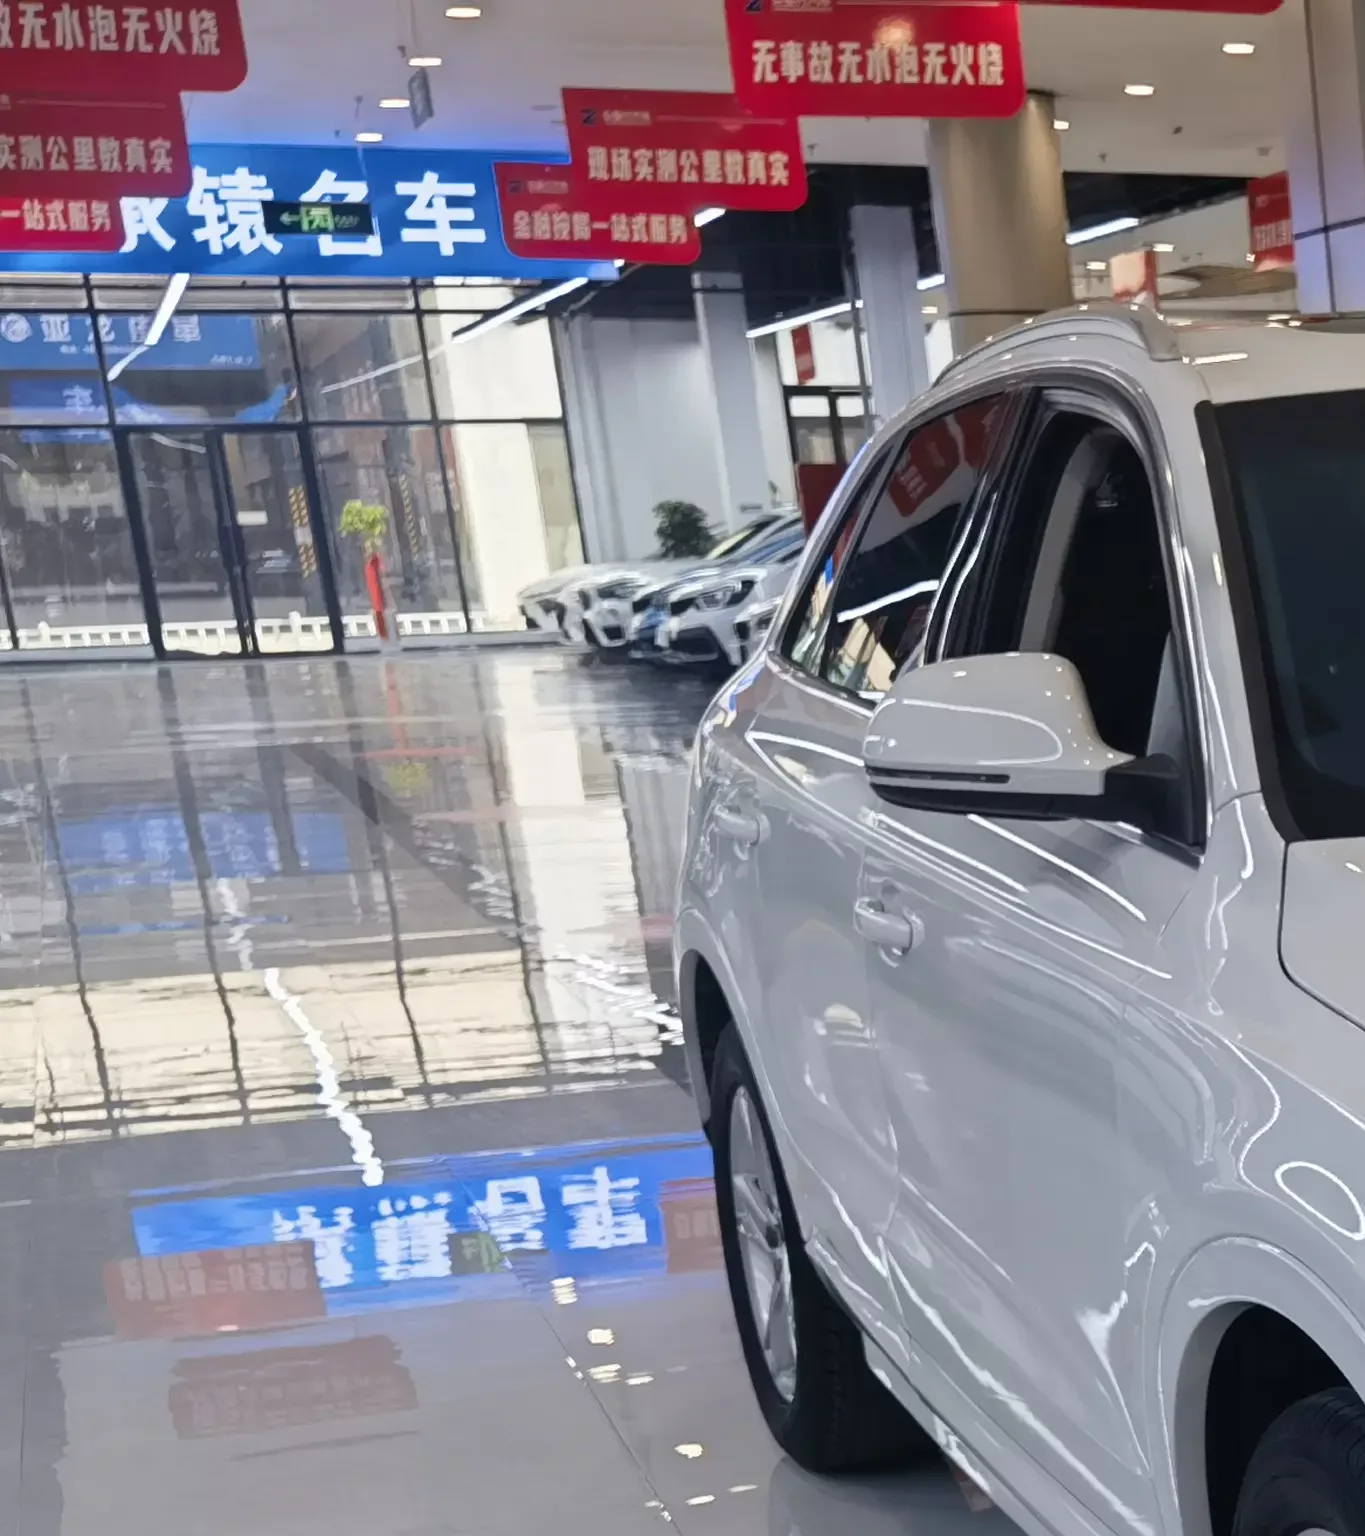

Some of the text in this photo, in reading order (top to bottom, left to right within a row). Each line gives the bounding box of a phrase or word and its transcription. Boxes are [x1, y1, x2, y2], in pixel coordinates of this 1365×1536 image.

[752, 40, 1004, 86] 无事故无水泡无火烧
